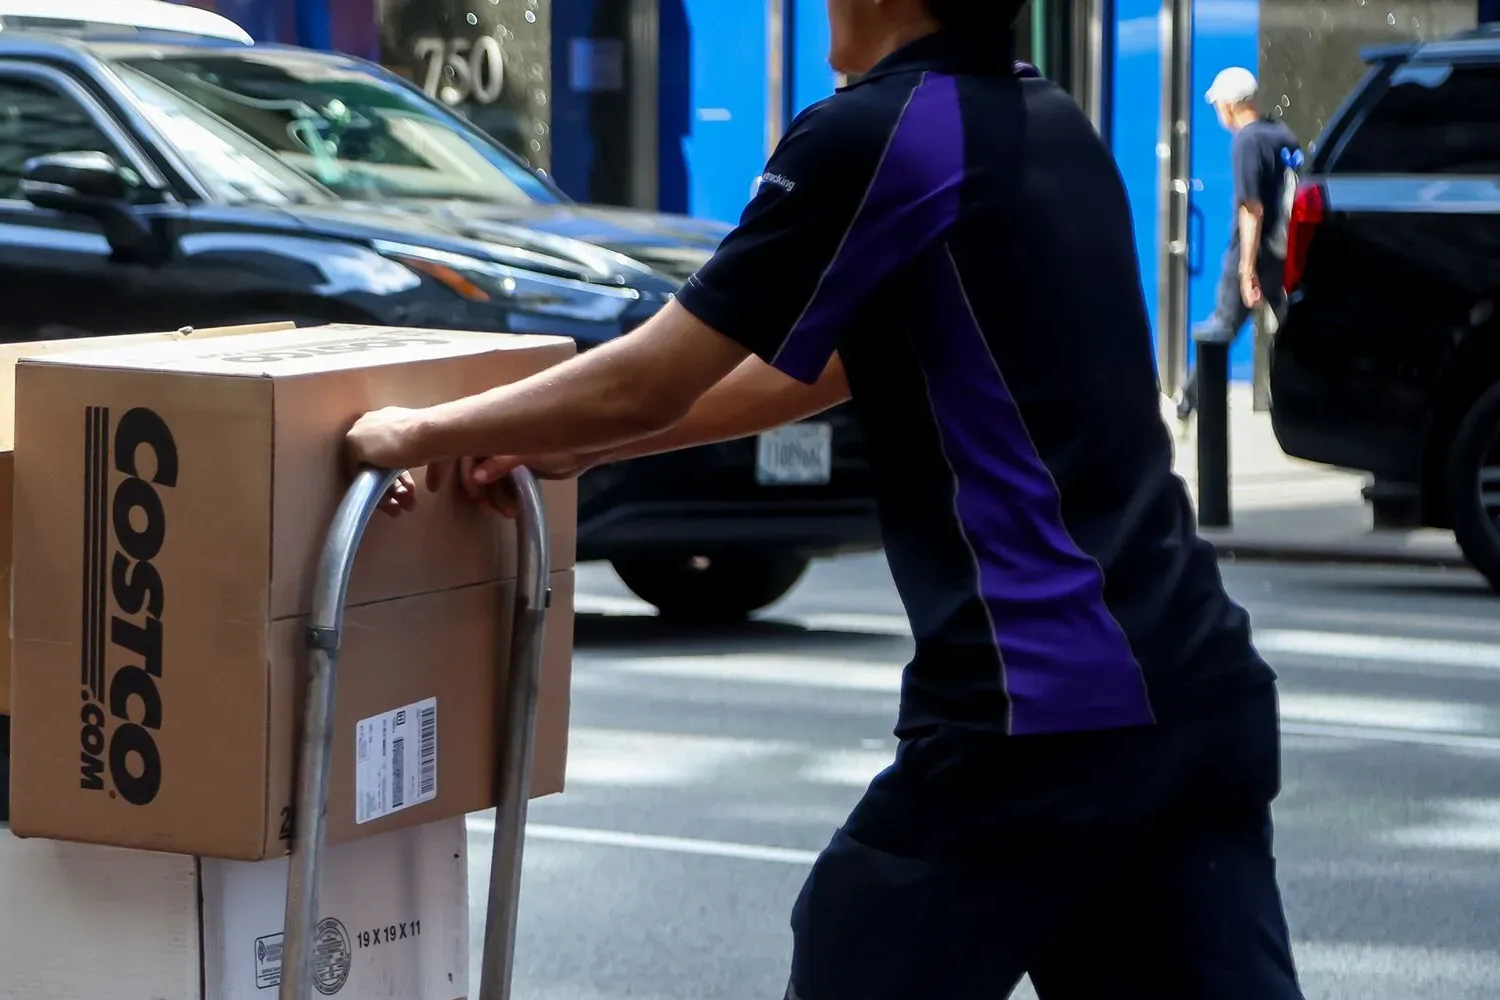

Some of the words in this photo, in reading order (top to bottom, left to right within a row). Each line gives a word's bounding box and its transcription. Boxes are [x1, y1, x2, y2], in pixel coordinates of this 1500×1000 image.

[414, 35, 503, 105] 750
[109, 407, 179, 805] COSTCO
[80, 684, 105, 790] .COM
[357, 933, 370, 949] 19
[373, 929, 381, 946] X
[383, 924, 397, 942] 19
[399, 922, 408, 939] X
[410, 920, 421, 937] 11
